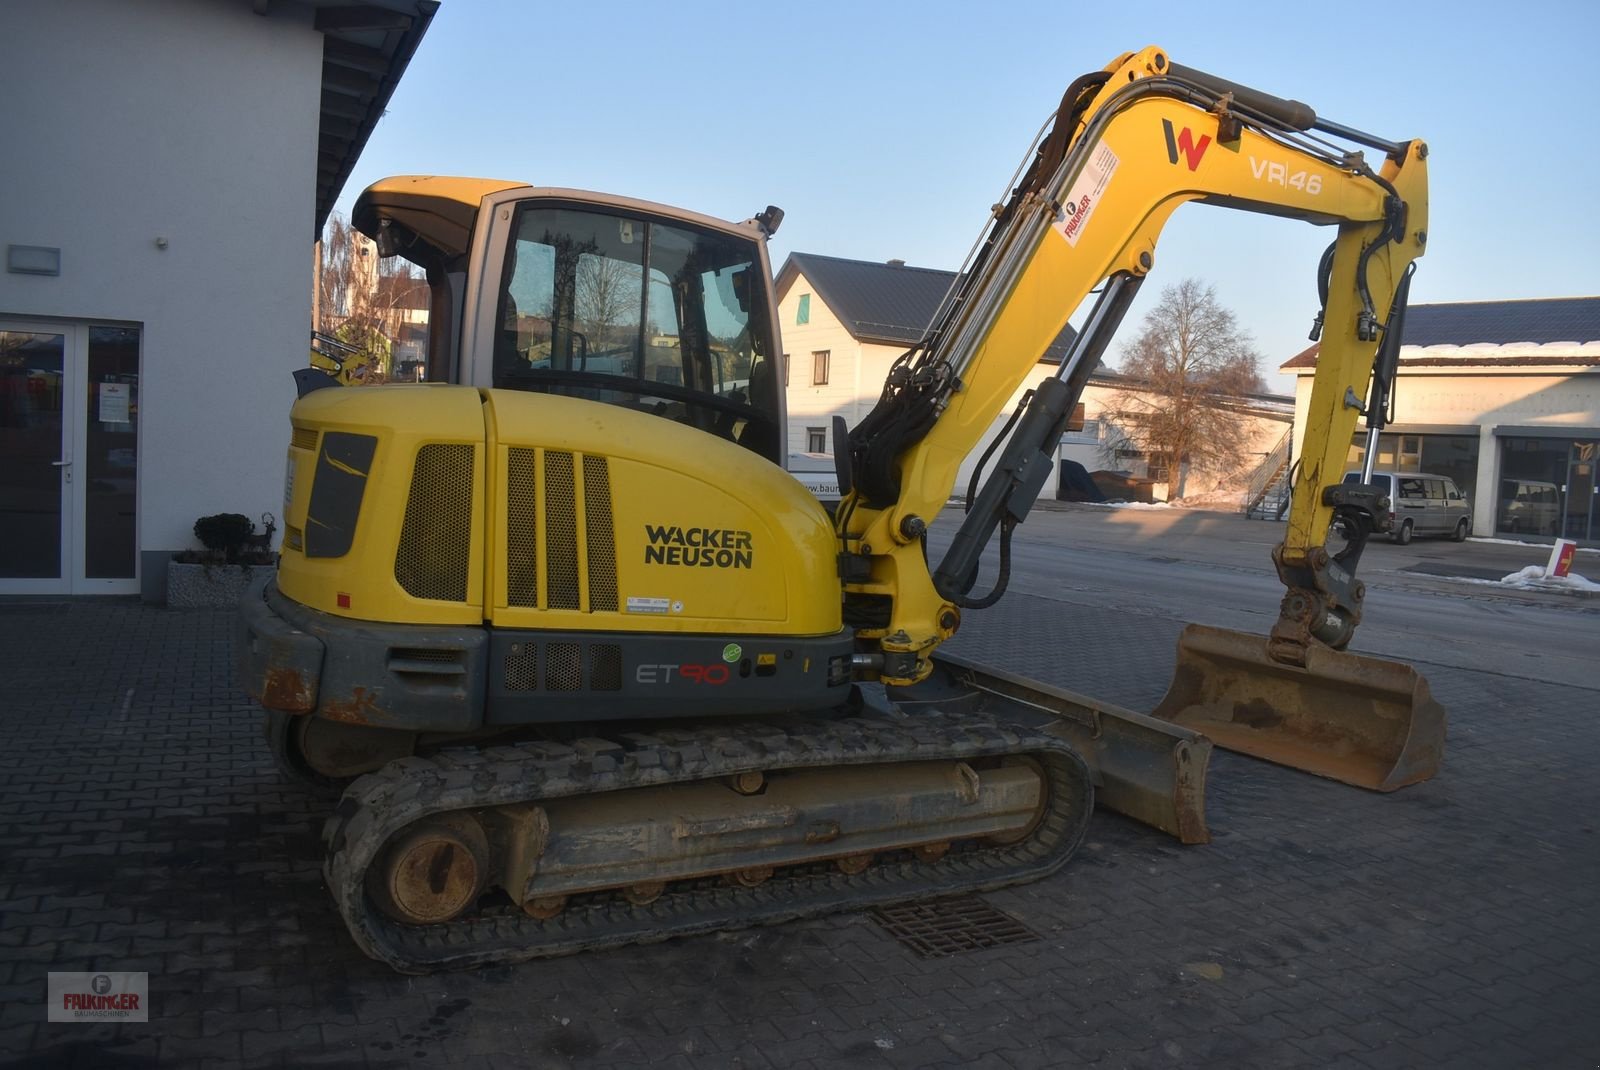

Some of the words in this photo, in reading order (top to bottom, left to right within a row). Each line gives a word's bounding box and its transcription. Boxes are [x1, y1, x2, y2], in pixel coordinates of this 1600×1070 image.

[1064, 195, 1091, 238] FALKINGER
[644, 524, 752, 550] WACKER
[644, 545, 752, 569] NEUSON
[636, 663, 730, 685] ET90
